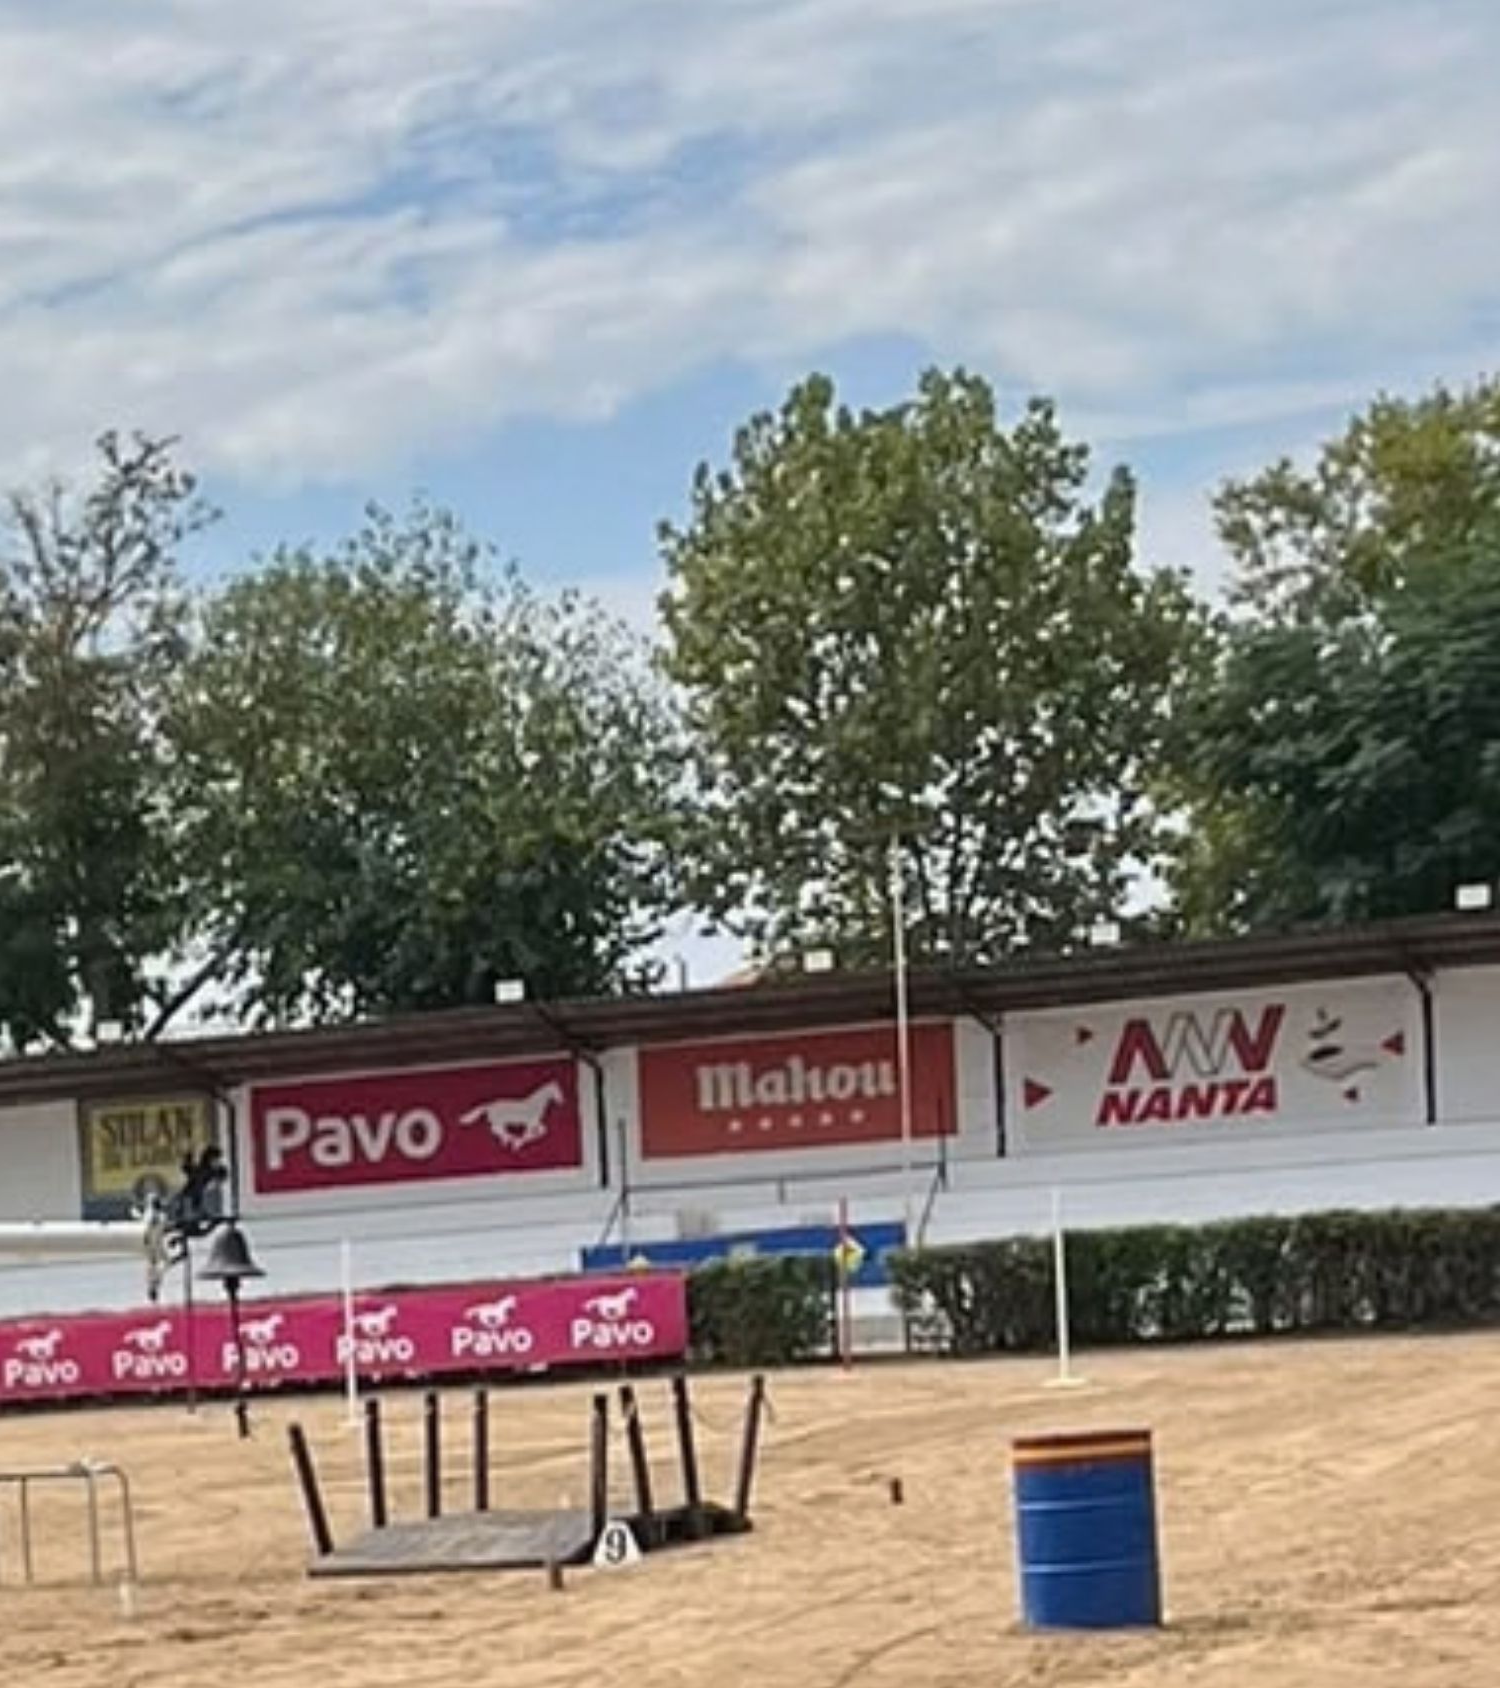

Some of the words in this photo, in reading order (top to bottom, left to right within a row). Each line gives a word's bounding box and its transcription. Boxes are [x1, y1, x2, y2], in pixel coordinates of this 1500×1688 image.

[697, 1055, 897, 1110] Mahou
[1096, 1076, 1278, 1126] NANTA
[265, 1108, 441, 1170] Pavo
[4, 1358, 78, 1388] Pavo
[111, 1350, 188, 1379] Pavo
[452, 1327, 533, 1357] Pavo
[571, 1318, 655, 1348] Pavo
[605, 1527, 627, 1564] 9
